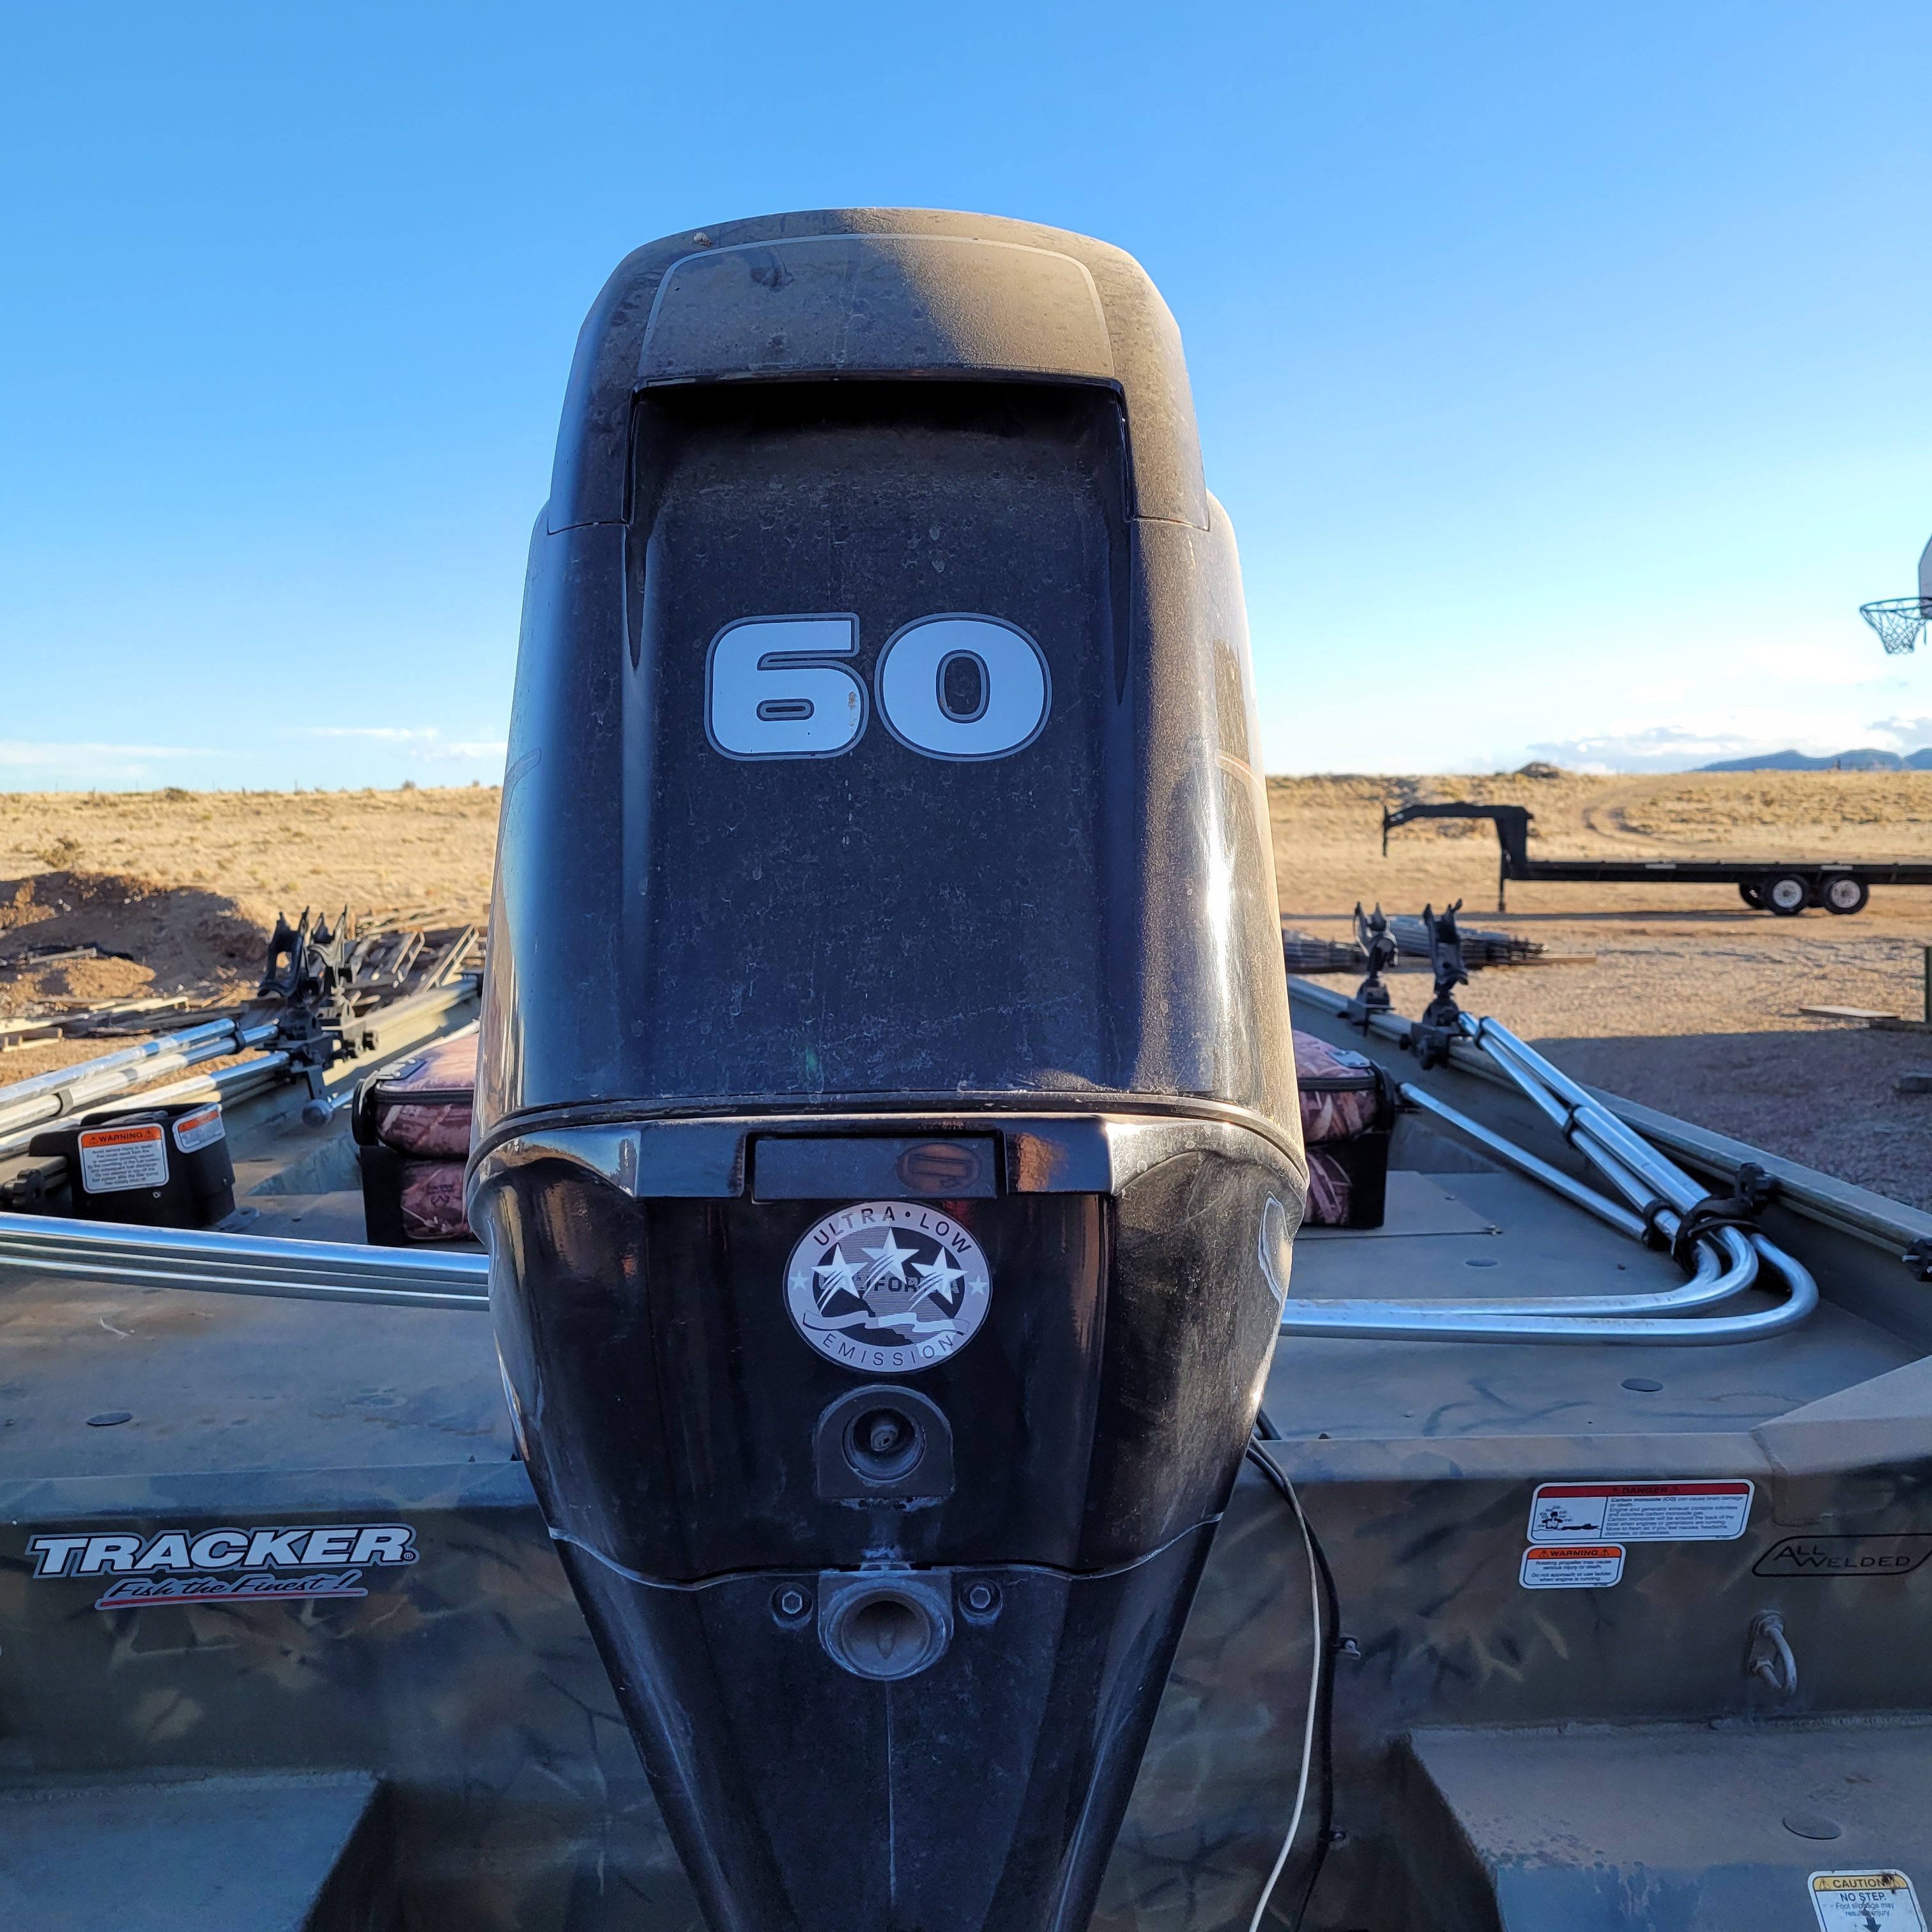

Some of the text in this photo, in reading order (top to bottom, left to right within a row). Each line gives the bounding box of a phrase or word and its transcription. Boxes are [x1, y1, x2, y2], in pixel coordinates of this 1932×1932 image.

[705, 612, 1052, 762] 60
[98, 1131, 144, 1142] WARNING
[813, 1206, 973, 1255] ULTRA LOW
[823, 1333, 954, 1367] EMISSION
[109, 1581, 176, 1597] Fish
[181, 1578, 227, 1594] the
[1832, 1878, 1886, 1888] CAUTION
[1840, 1893, 1856, 1902] NO
